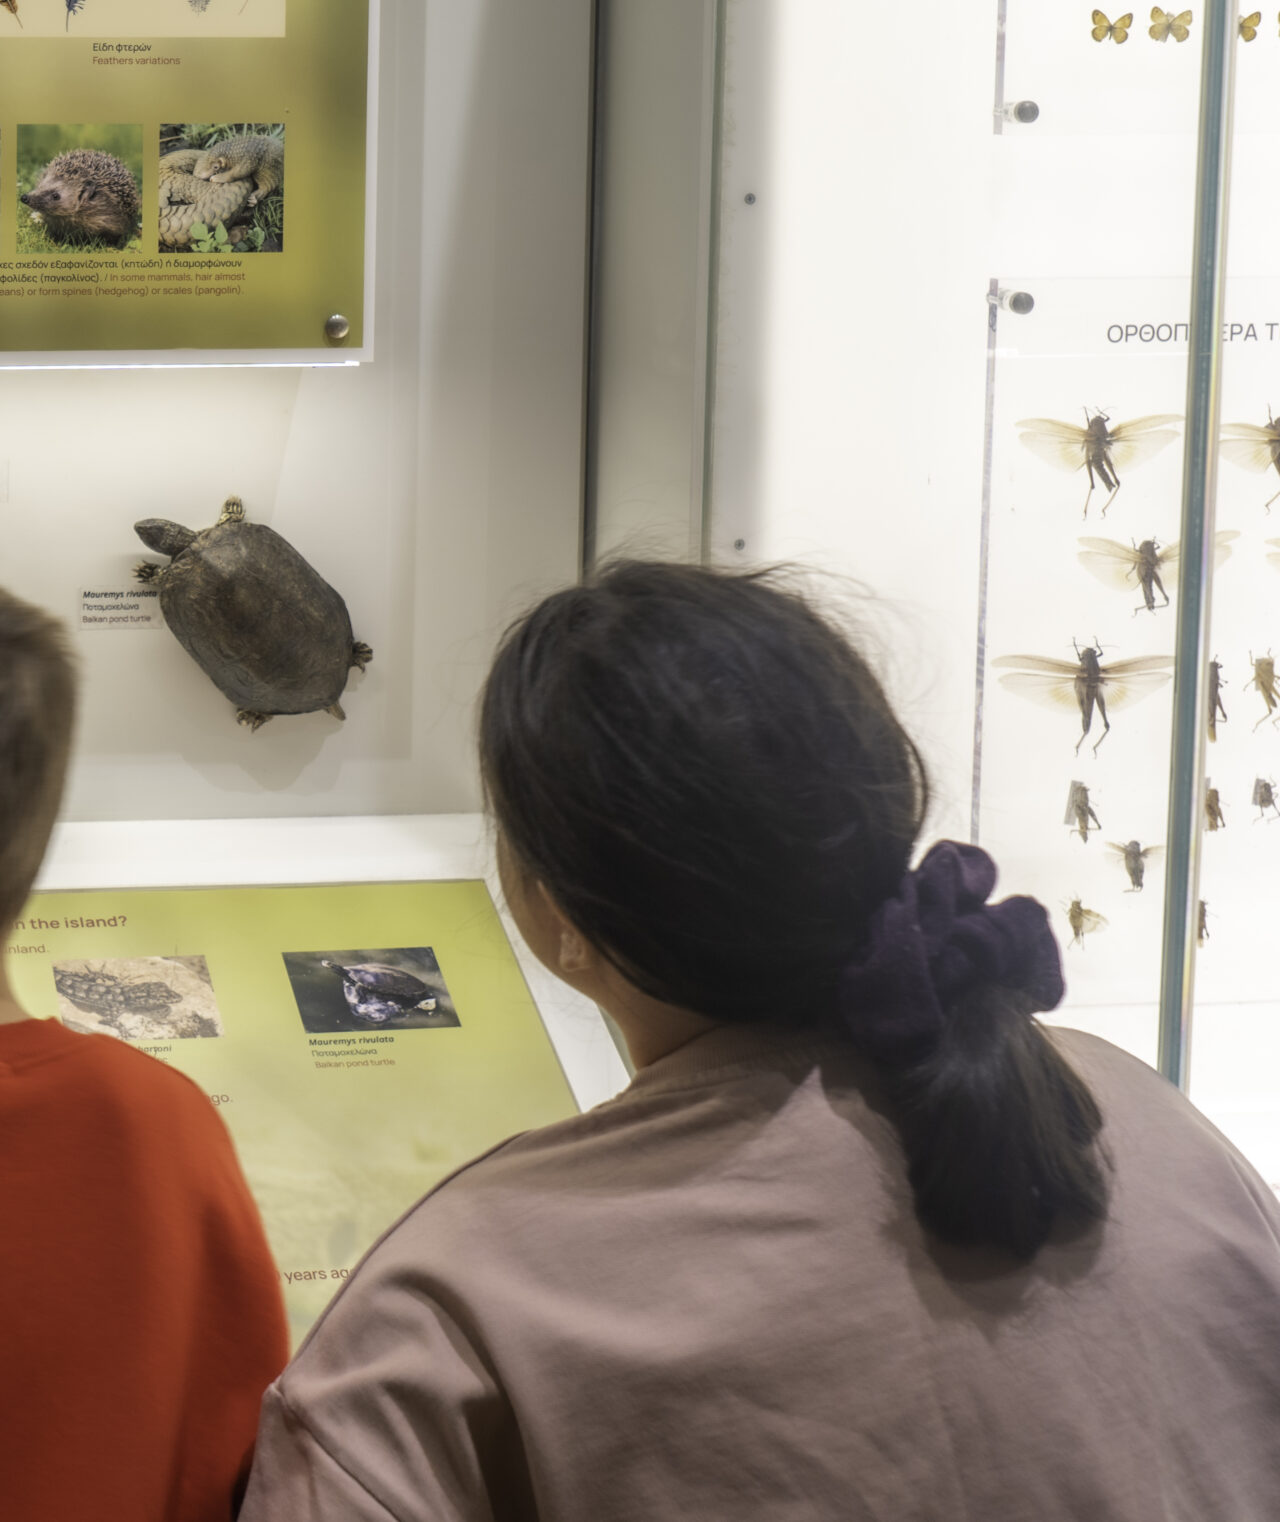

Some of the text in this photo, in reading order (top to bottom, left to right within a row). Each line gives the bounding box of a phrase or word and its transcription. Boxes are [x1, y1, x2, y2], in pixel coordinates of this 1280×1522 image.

[93, 43, 152, 53] Είδη φτερών
[16, 260, 48, 270] σχεδόν
[174, 258, 242, 269] διαμορφώνουν
[0, 273, 37, 283] φολίδες
[121, 274, 146, 282] some
[195, 272, 213, 281] hair
[215, 272, 246, 281] almost
[39, 287, 60, 296] form
[62, 286, 92, 297] spines
[95, 286, 149, 298] (hedgehog)
[163, 286, 192, 295] scales
[1107, 323, 1258, 343] ΟΡΘΟΠΡΑ
[83, 590, 157, 599] Mauremys rivulata
[30, 916, 127, 930] the island?
[309, 1038, 356, 1046] Mauremys
[283, 1270, 327, 1284] years
